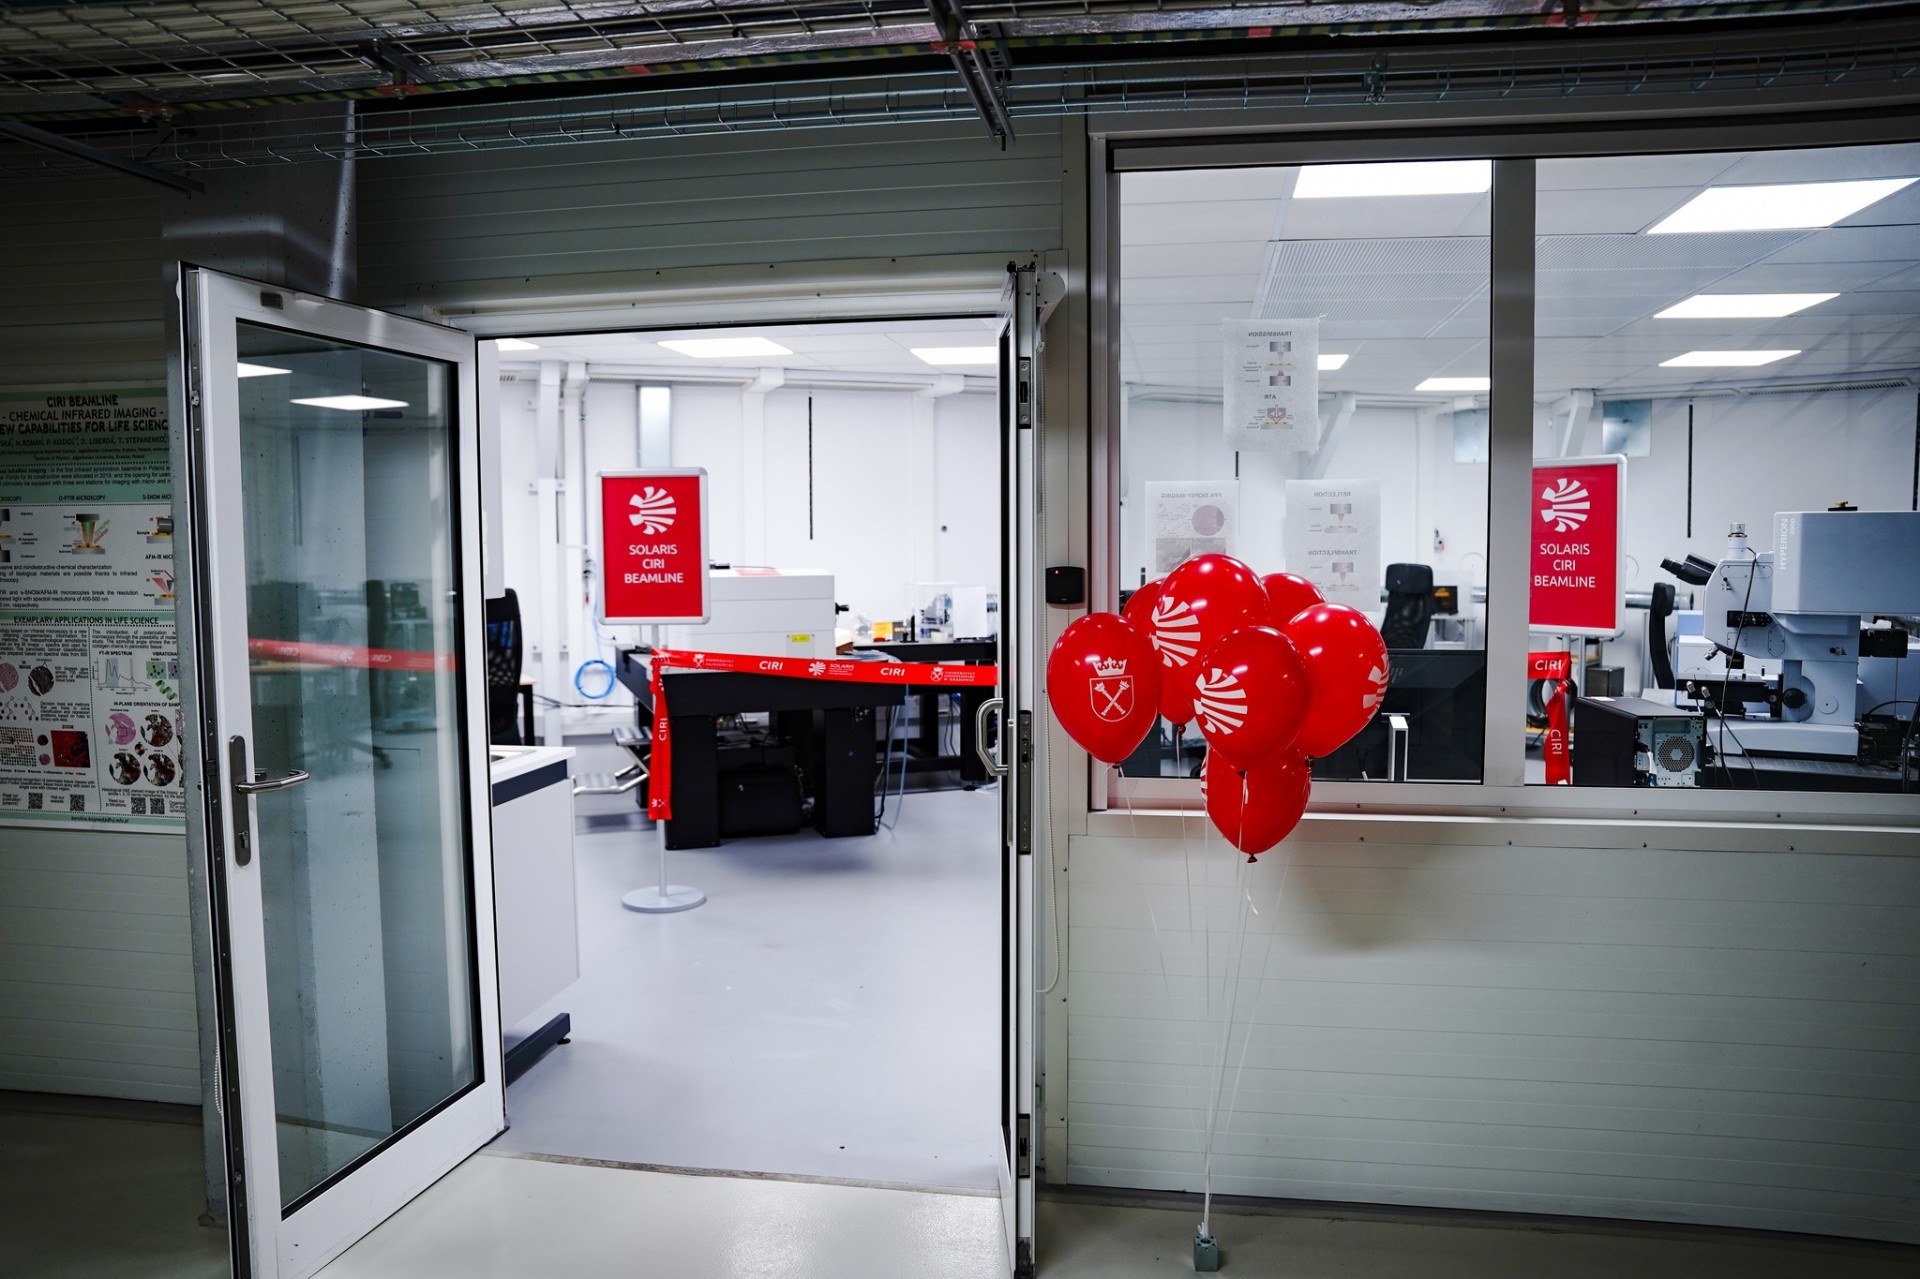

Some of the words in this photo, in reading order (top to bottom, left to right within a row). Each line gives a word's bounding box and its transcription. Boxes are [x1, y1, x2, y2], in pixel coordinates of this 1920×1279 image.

[47, 396, 66, 408] CIRI
[70, 394, 118, 407] BEAMLINE
[9, 410, 58, 422] CHEMICAL
[63, 409, 110, 420] INFRARED
[114, 407, 157, 419] IMAGING
[18, 422, 82, 434] CAPABILITIES
[85, 422, 105, 432] FOR
[109, 421, 129, 432] LIFE
[629, 544, 678, 555] SOLARIS
[1539, 543, 1590, 555] SOLARIS
[1779, 518, 1789, 570] HYPERION
[642, 558, 665, 569] CIRI
[1553, 559, 1576, 571] CIRI
[624, 573, 684, 584] BEAMLINE
[1534, 575, 1596, 588] BEAMLINE
[14, 616, 53, 624] EXEMPLARY
[759, 660, 784, 671] CIRI
[1535, 659, 1562, 671] CIRI
[880, 667, 906, 677] CIRI
[659, 717, 668, 741] CIRI
[1550, 729, 1562, 755] CIRI
